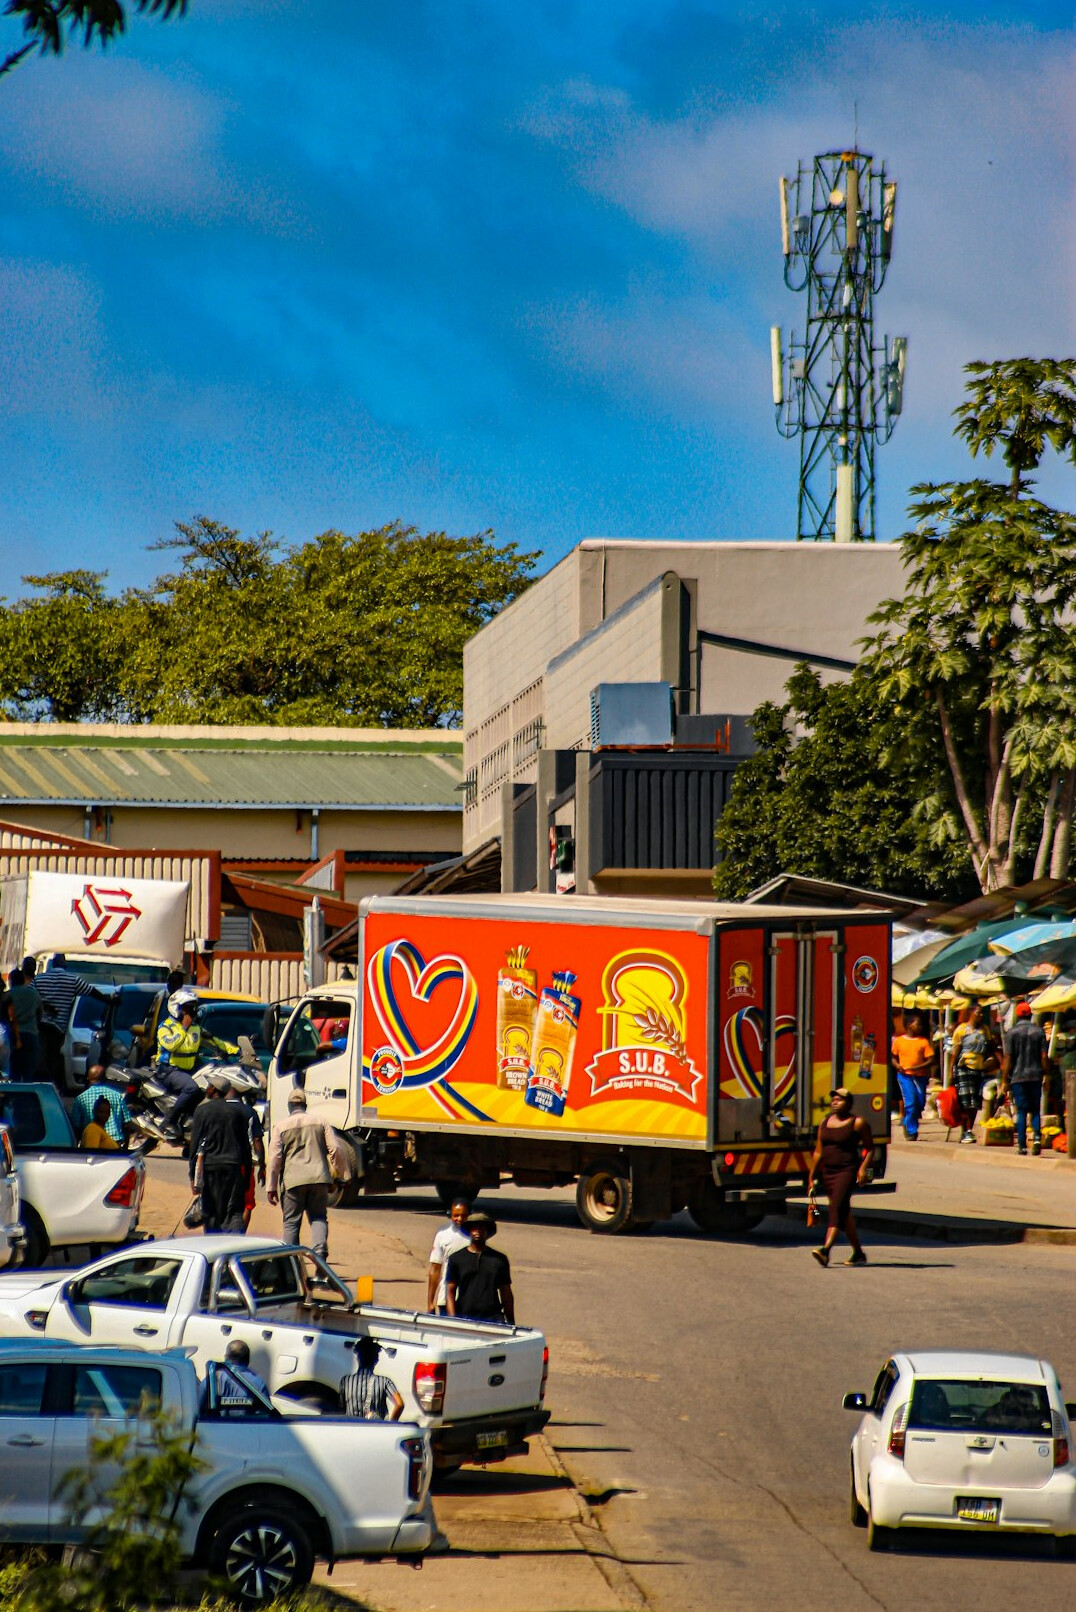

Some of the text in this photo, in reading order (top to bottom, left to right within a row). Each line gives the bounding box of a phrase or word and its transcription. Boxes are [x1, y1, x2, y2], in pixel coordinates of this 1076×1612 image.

[619, 1052, 670, 1077] S.U.B.
[505, 1071, 527, 1079] BROWN
[507, 1078, 526, 1086] BREAD
[538, 1077, 555, 1089] S.U.B.
[613, 1079, 674, 1093] Baking for the Nation
[536, 1090, 553, 1099] WHITE
[534, 1096, 553, 1108] BREAD
